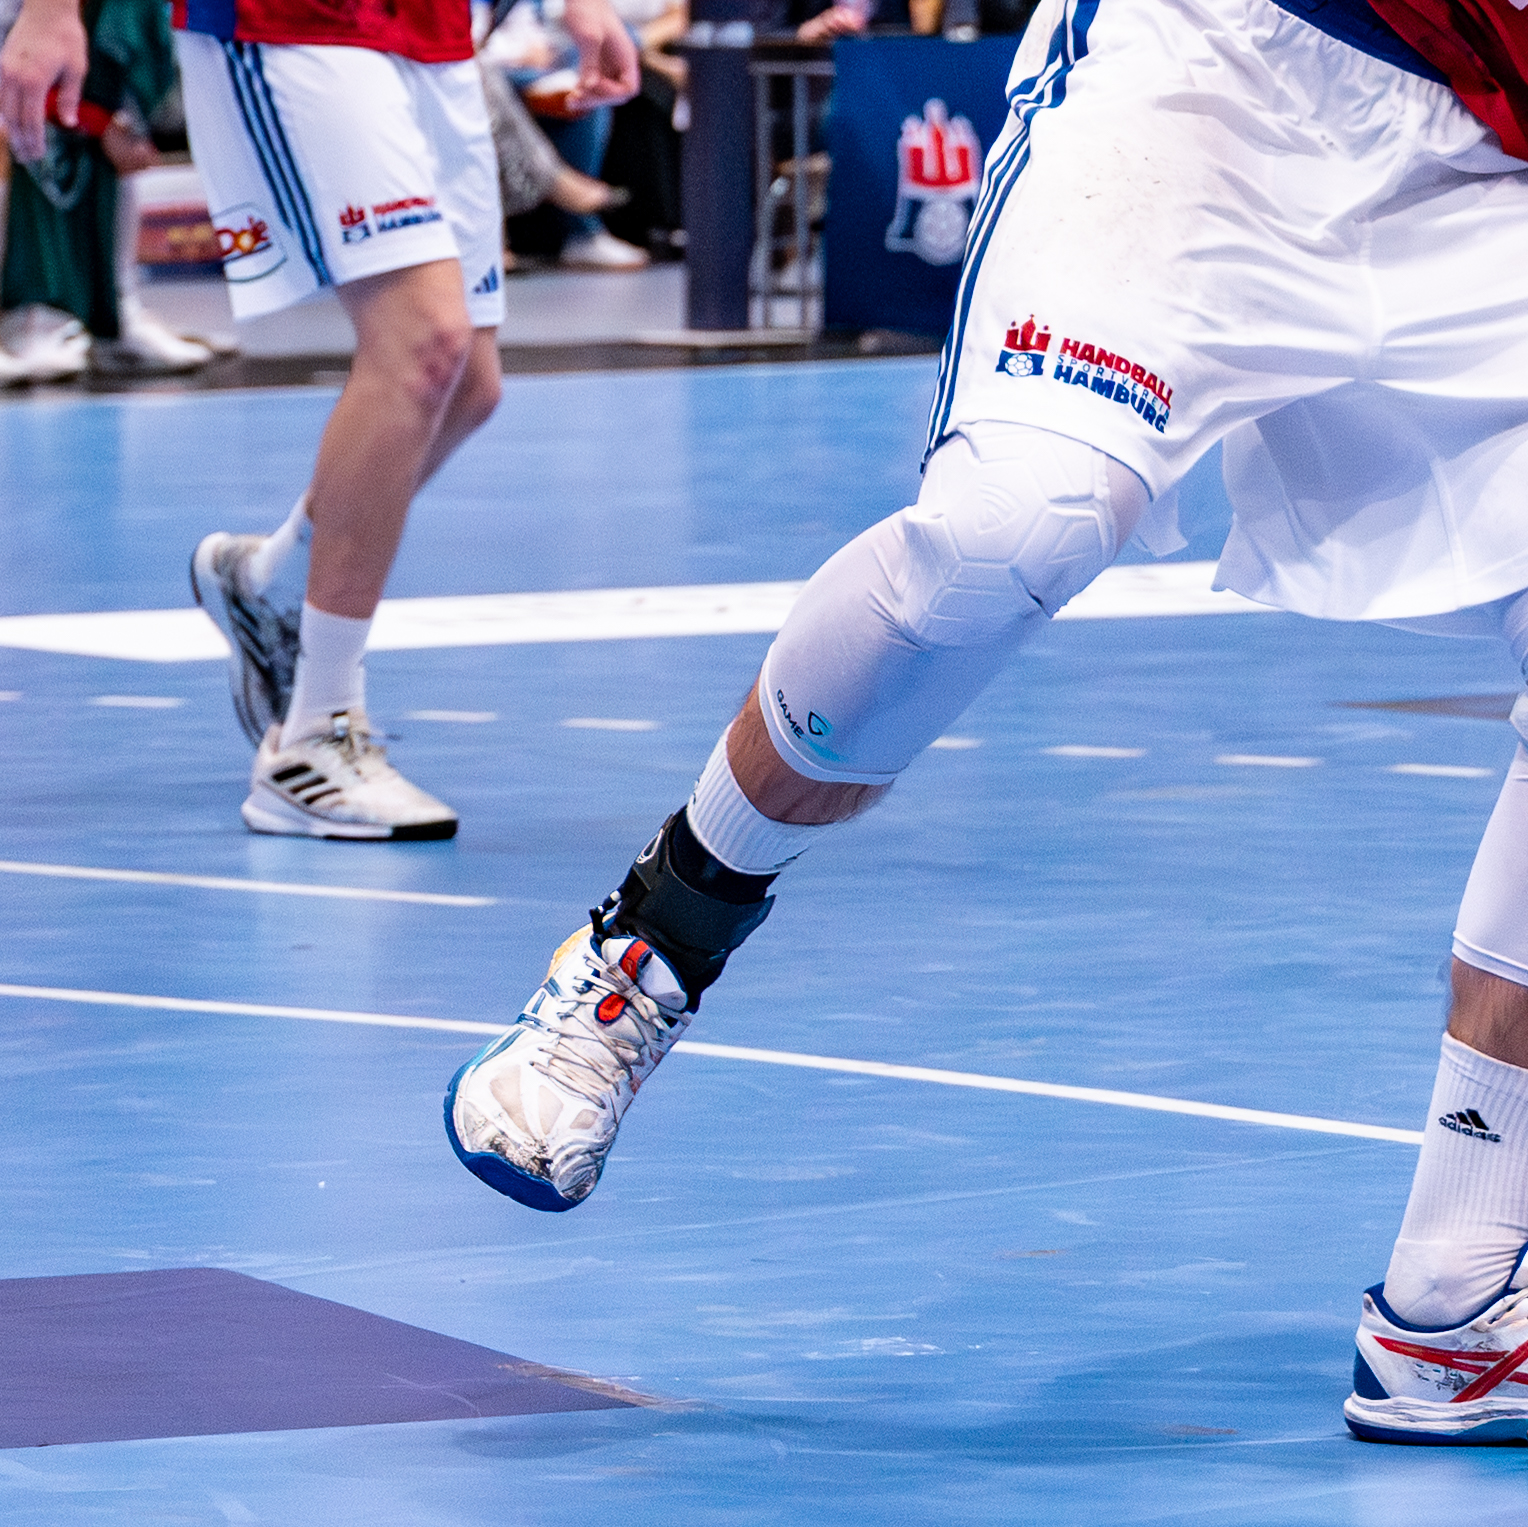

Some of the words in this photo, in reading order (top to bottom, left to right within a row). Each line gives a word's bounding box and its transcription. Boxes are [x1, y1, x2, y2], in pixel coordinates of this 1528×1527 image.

[1052, 364, 1168, 435] HAMBURG
[1059, 336, 1174, 410] HANDBALL
[1438, 1116, 1502, 1143] adidas
